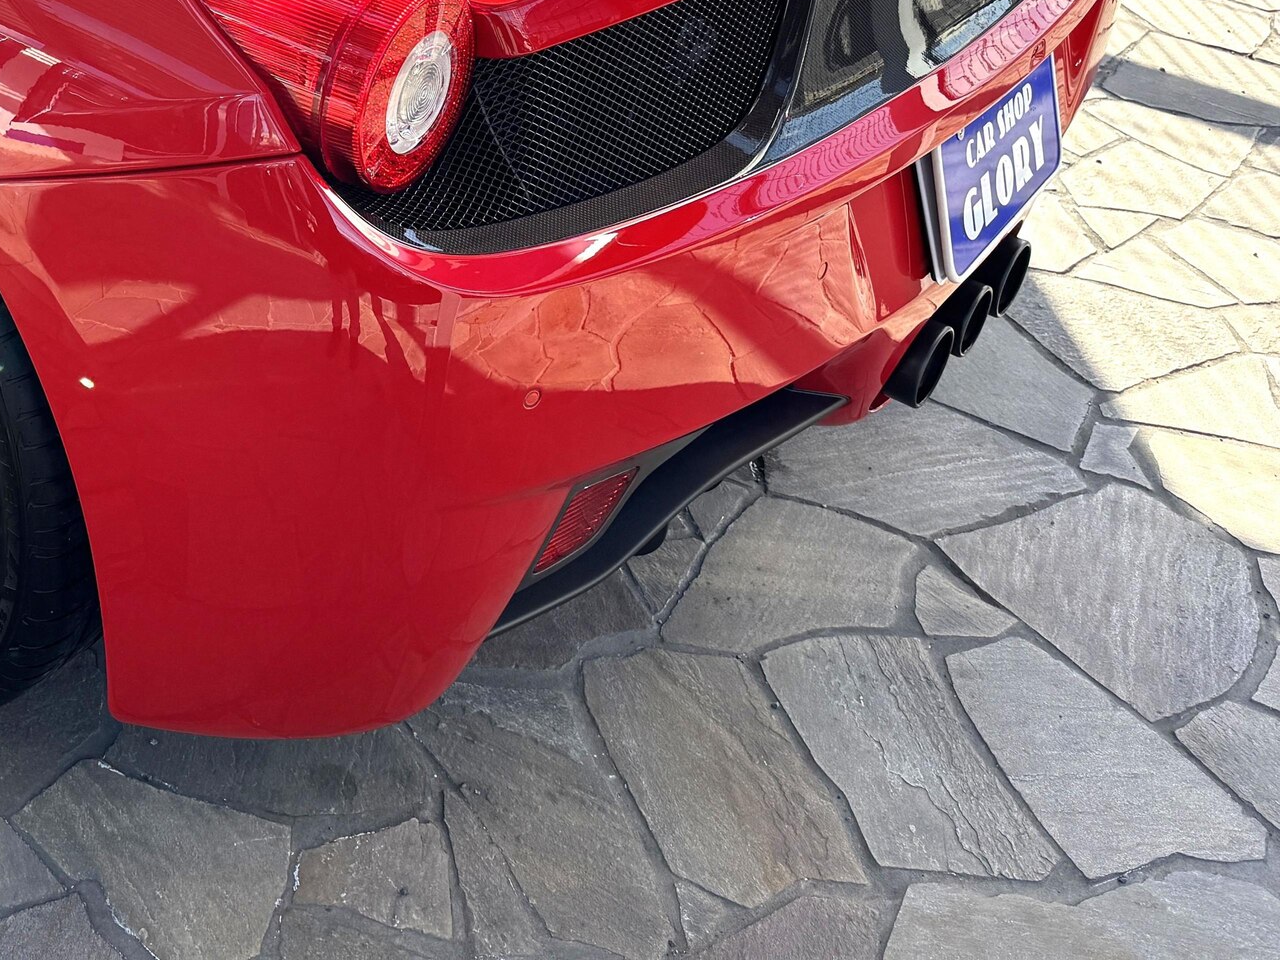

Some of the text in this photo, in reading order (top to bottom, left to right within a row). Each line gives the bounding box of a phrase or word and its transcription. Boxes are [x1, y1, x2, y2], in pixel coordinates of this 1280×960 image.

[963, 114, 1045, 241] GLORY
[966, 82, 1033, 169] CAR SHOP
